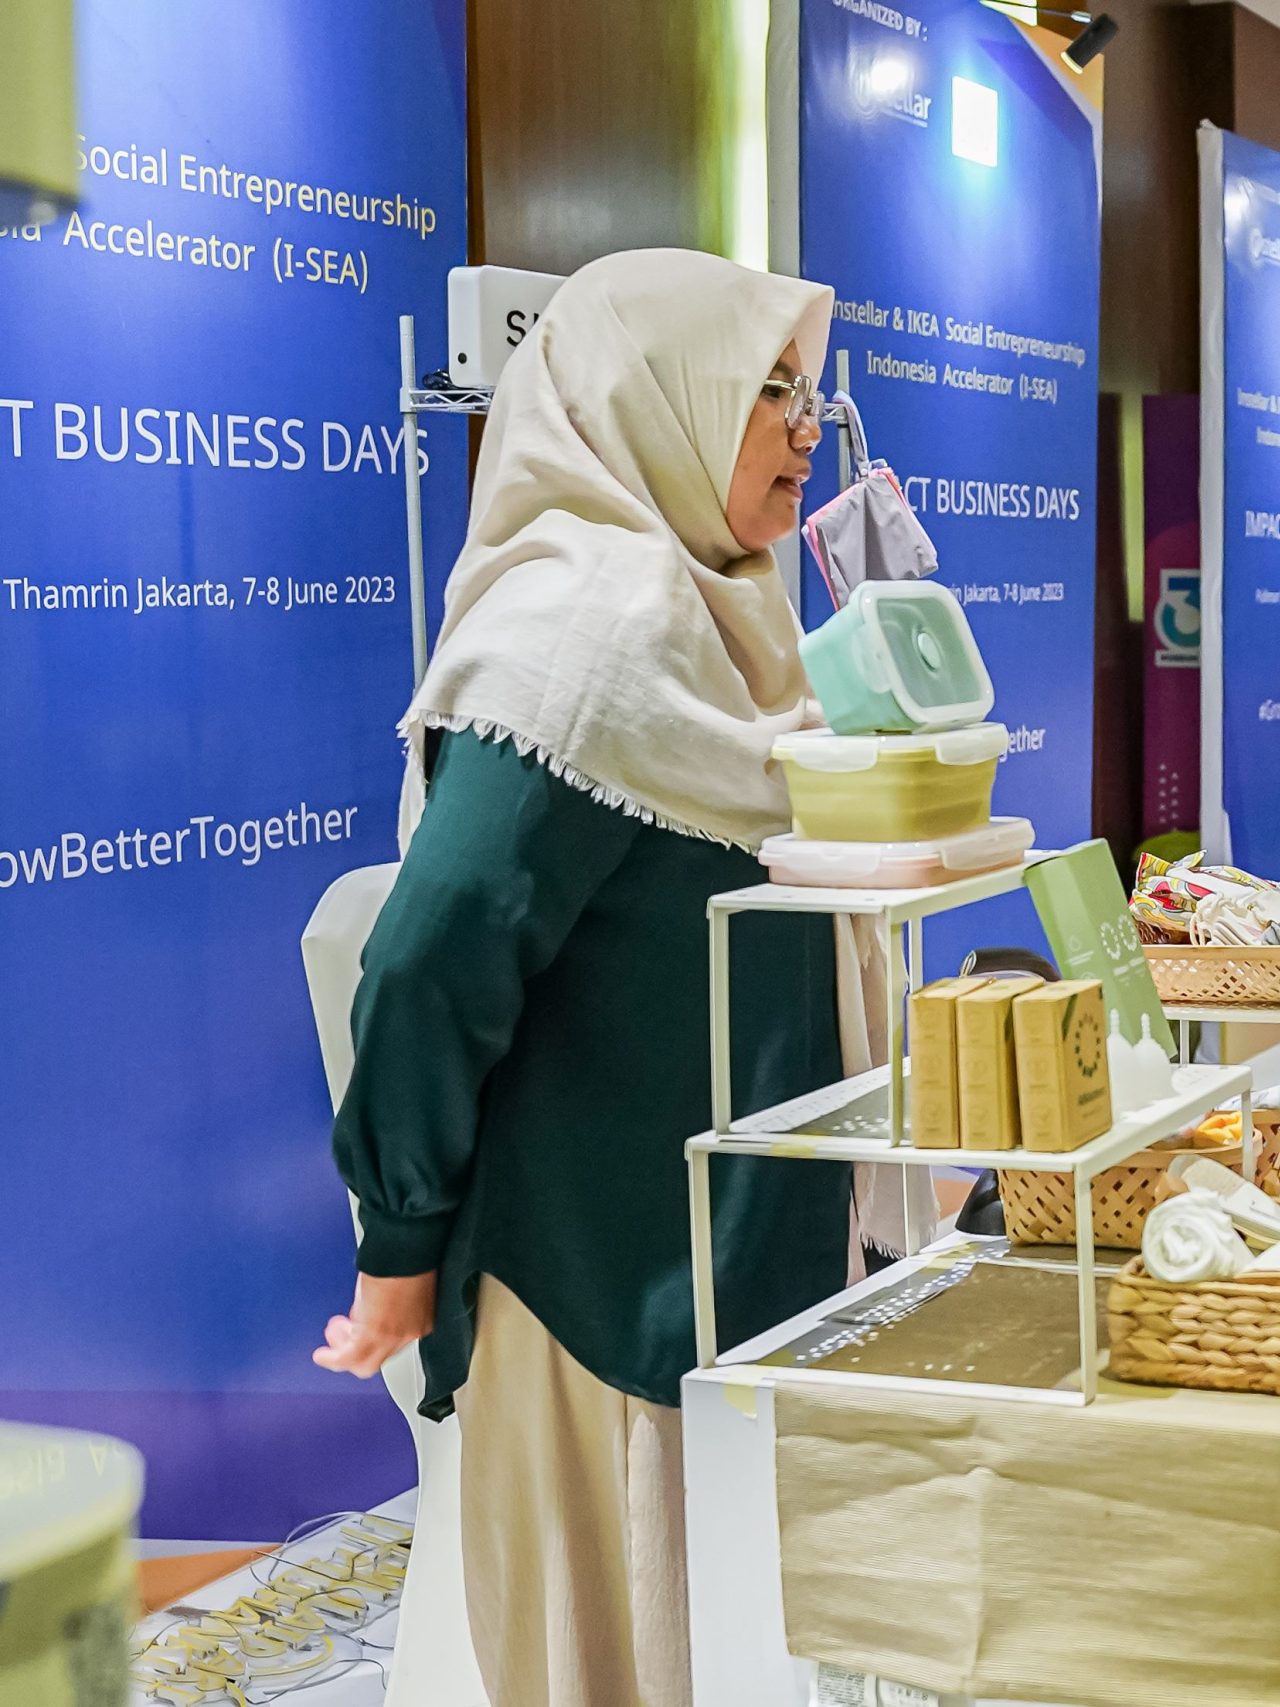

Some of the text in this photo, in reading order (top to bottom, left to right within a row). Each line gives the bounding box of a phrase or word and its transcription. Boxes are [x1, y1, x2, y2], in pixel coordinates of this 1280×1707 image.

[180, 154, 437, 240] Entrepreneurship
[63, 210, 369, 294] Accelerator (I-SEA)
[833, 300, 889, 328] nstellar
[893, 306, 904, 331] &
[907, 309, 940, 338] IKEA
[945, 317, 983, 346] Social
[867, 350, 1058, 404] Indonesia Accelerator (I-SEA)
[54, 402, 306, 471] BUSINESS
[322, 421, 430, 477] DAYS
[936, 478, 1031, 519] BUSINESS
[1035, 485, 1081, 522] DAYS
[3, 575, 396, 614] Thamrin Jakarta, 7-8 June 2023
